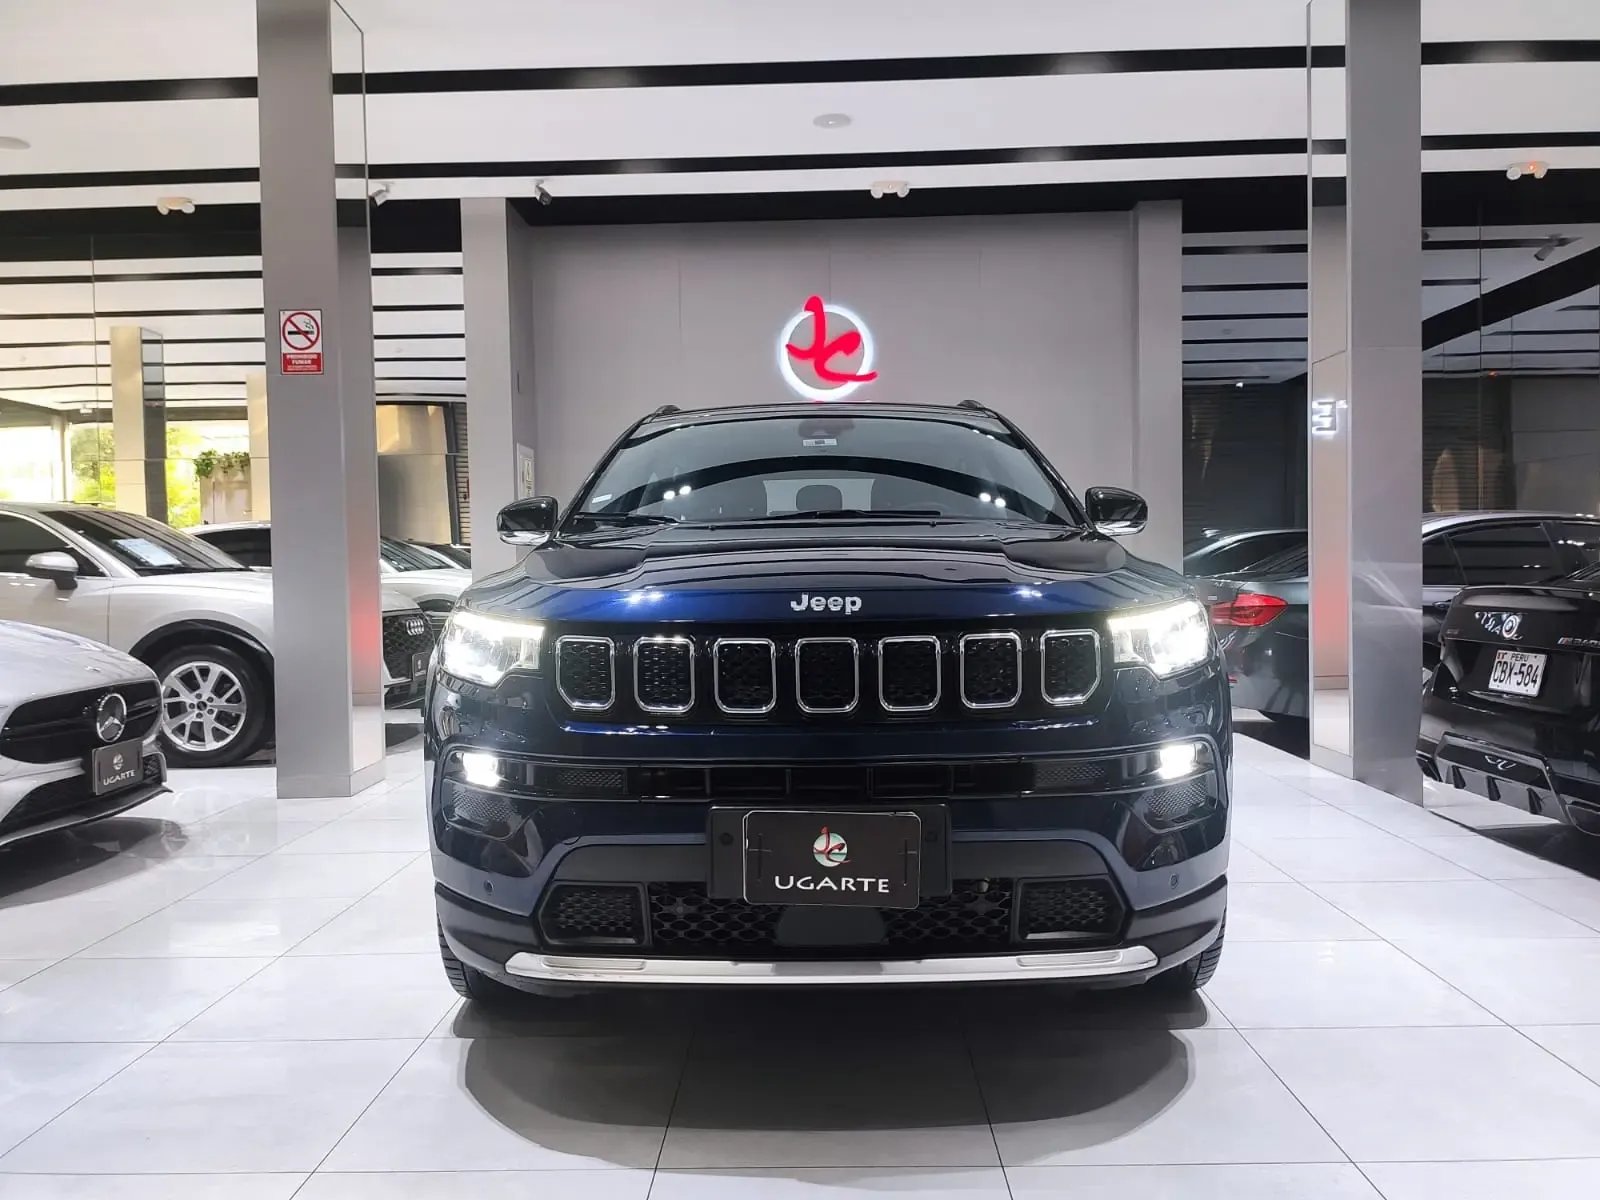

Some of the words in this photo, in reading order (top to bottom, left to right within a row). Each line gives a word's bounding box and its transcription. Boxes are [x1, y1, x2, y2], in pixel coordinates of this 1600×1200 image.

[790, 593, 862, 615] Jeep
[1493, 661, 1539, 688] CBX-584
[103, 769, 135, 785] UGARTE
[774, 875, 890, 893] UGARTE
